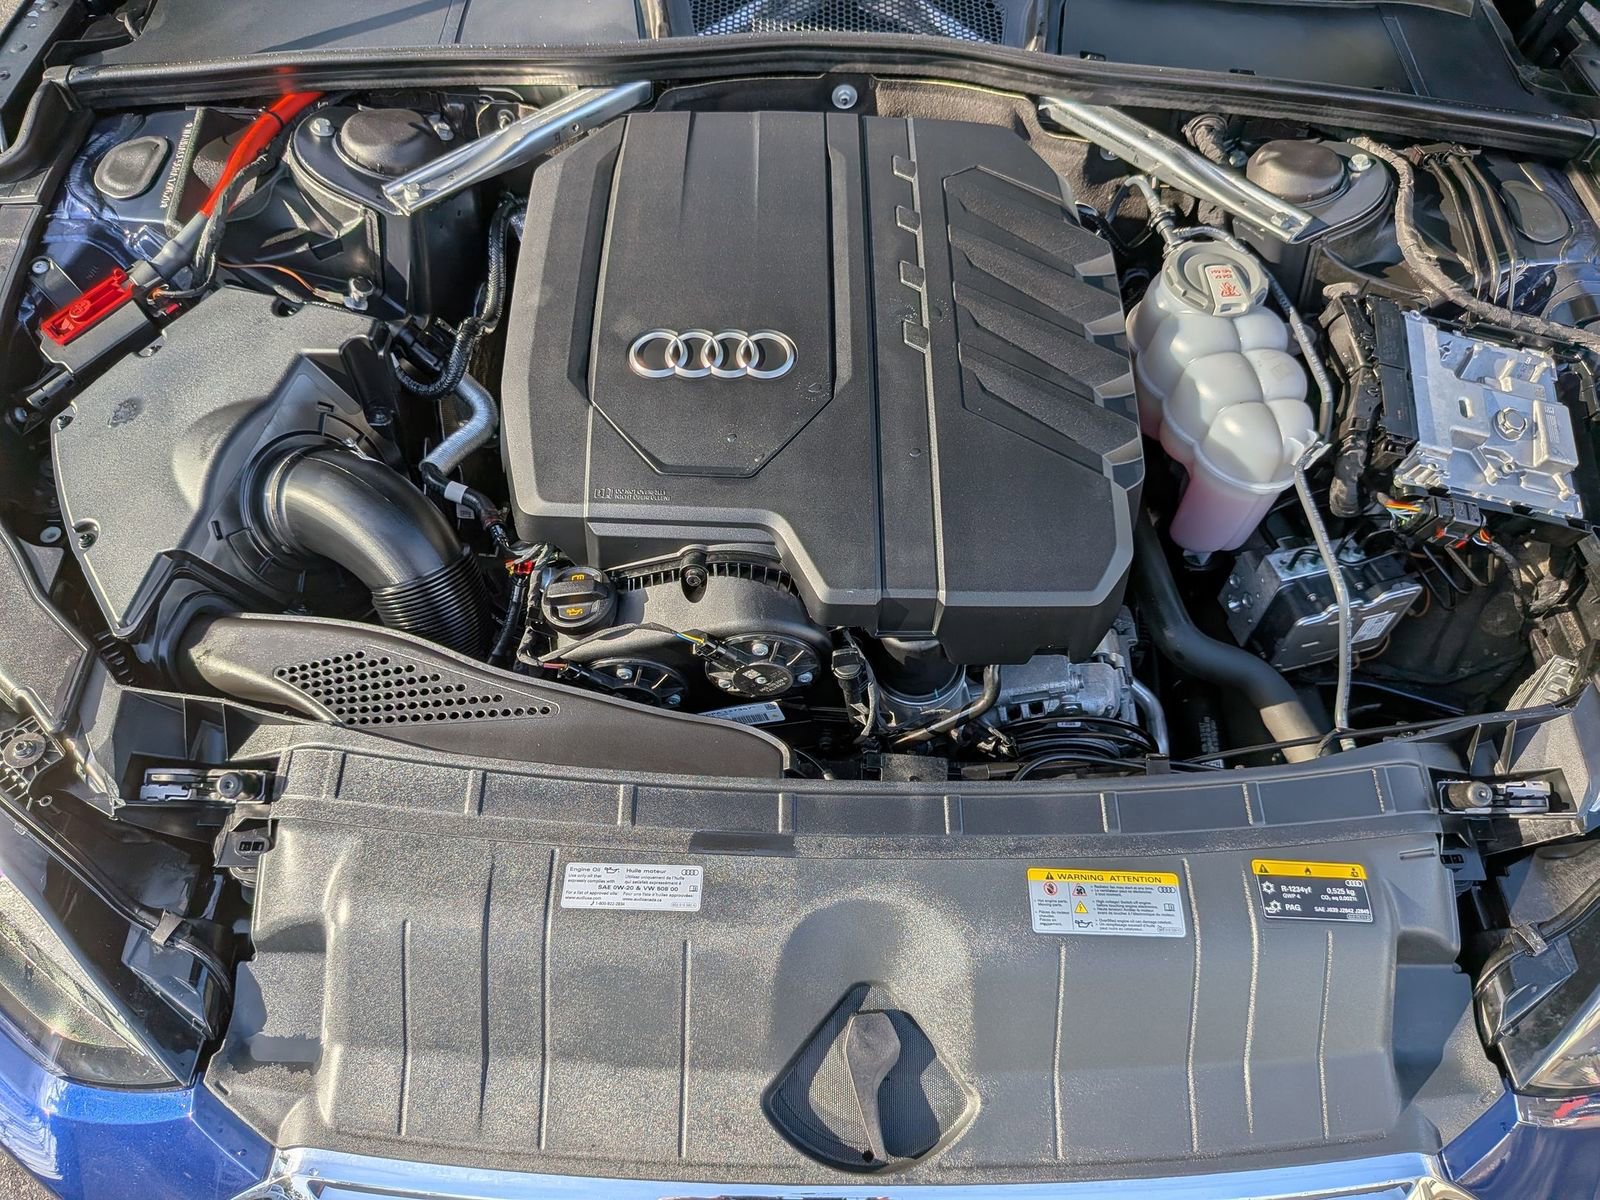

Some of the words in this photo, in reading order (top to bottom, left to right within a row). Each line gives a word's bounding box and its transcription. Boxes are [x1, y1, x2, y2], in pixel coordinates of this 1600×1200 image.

[1056, 873, 1104, 882] WARNING
[1110, 875, 1162, 884] ATTENTION
[1346, 888, 1356, 896] kg
[1284, 904, 1302, 912] PAG
